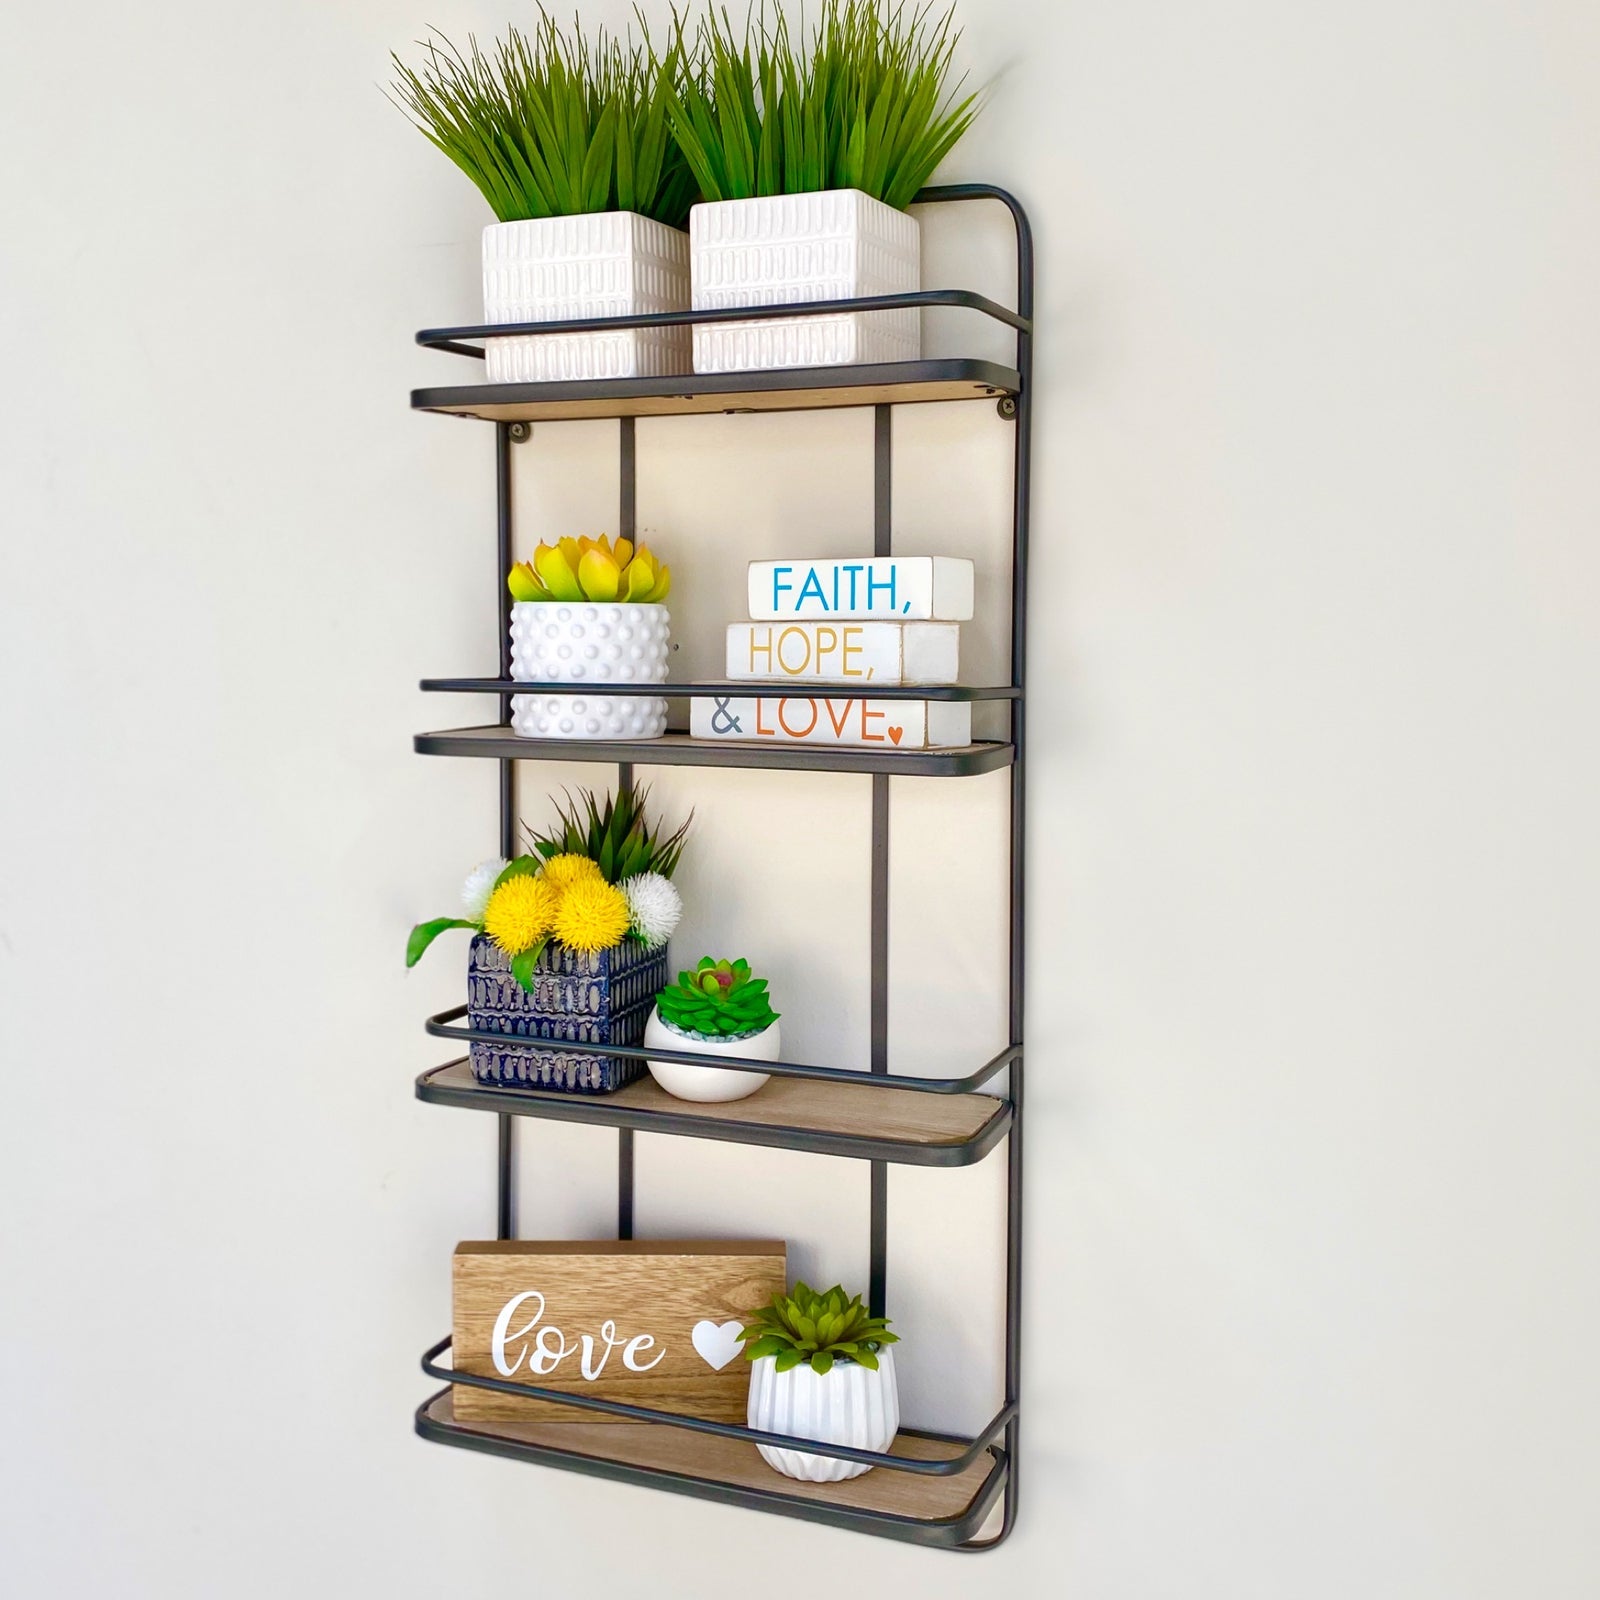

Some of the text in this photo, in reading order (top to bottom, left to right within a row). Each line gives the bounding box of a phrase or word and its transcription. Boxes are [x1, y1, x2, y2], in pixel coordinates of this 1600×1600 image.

[773, 565, 911, 614] FAITH,
[750, 626, 874, 681] HOPE,
[711, 697, 885, 741] & LOVE
[491, 1290, 666, 1381] love
